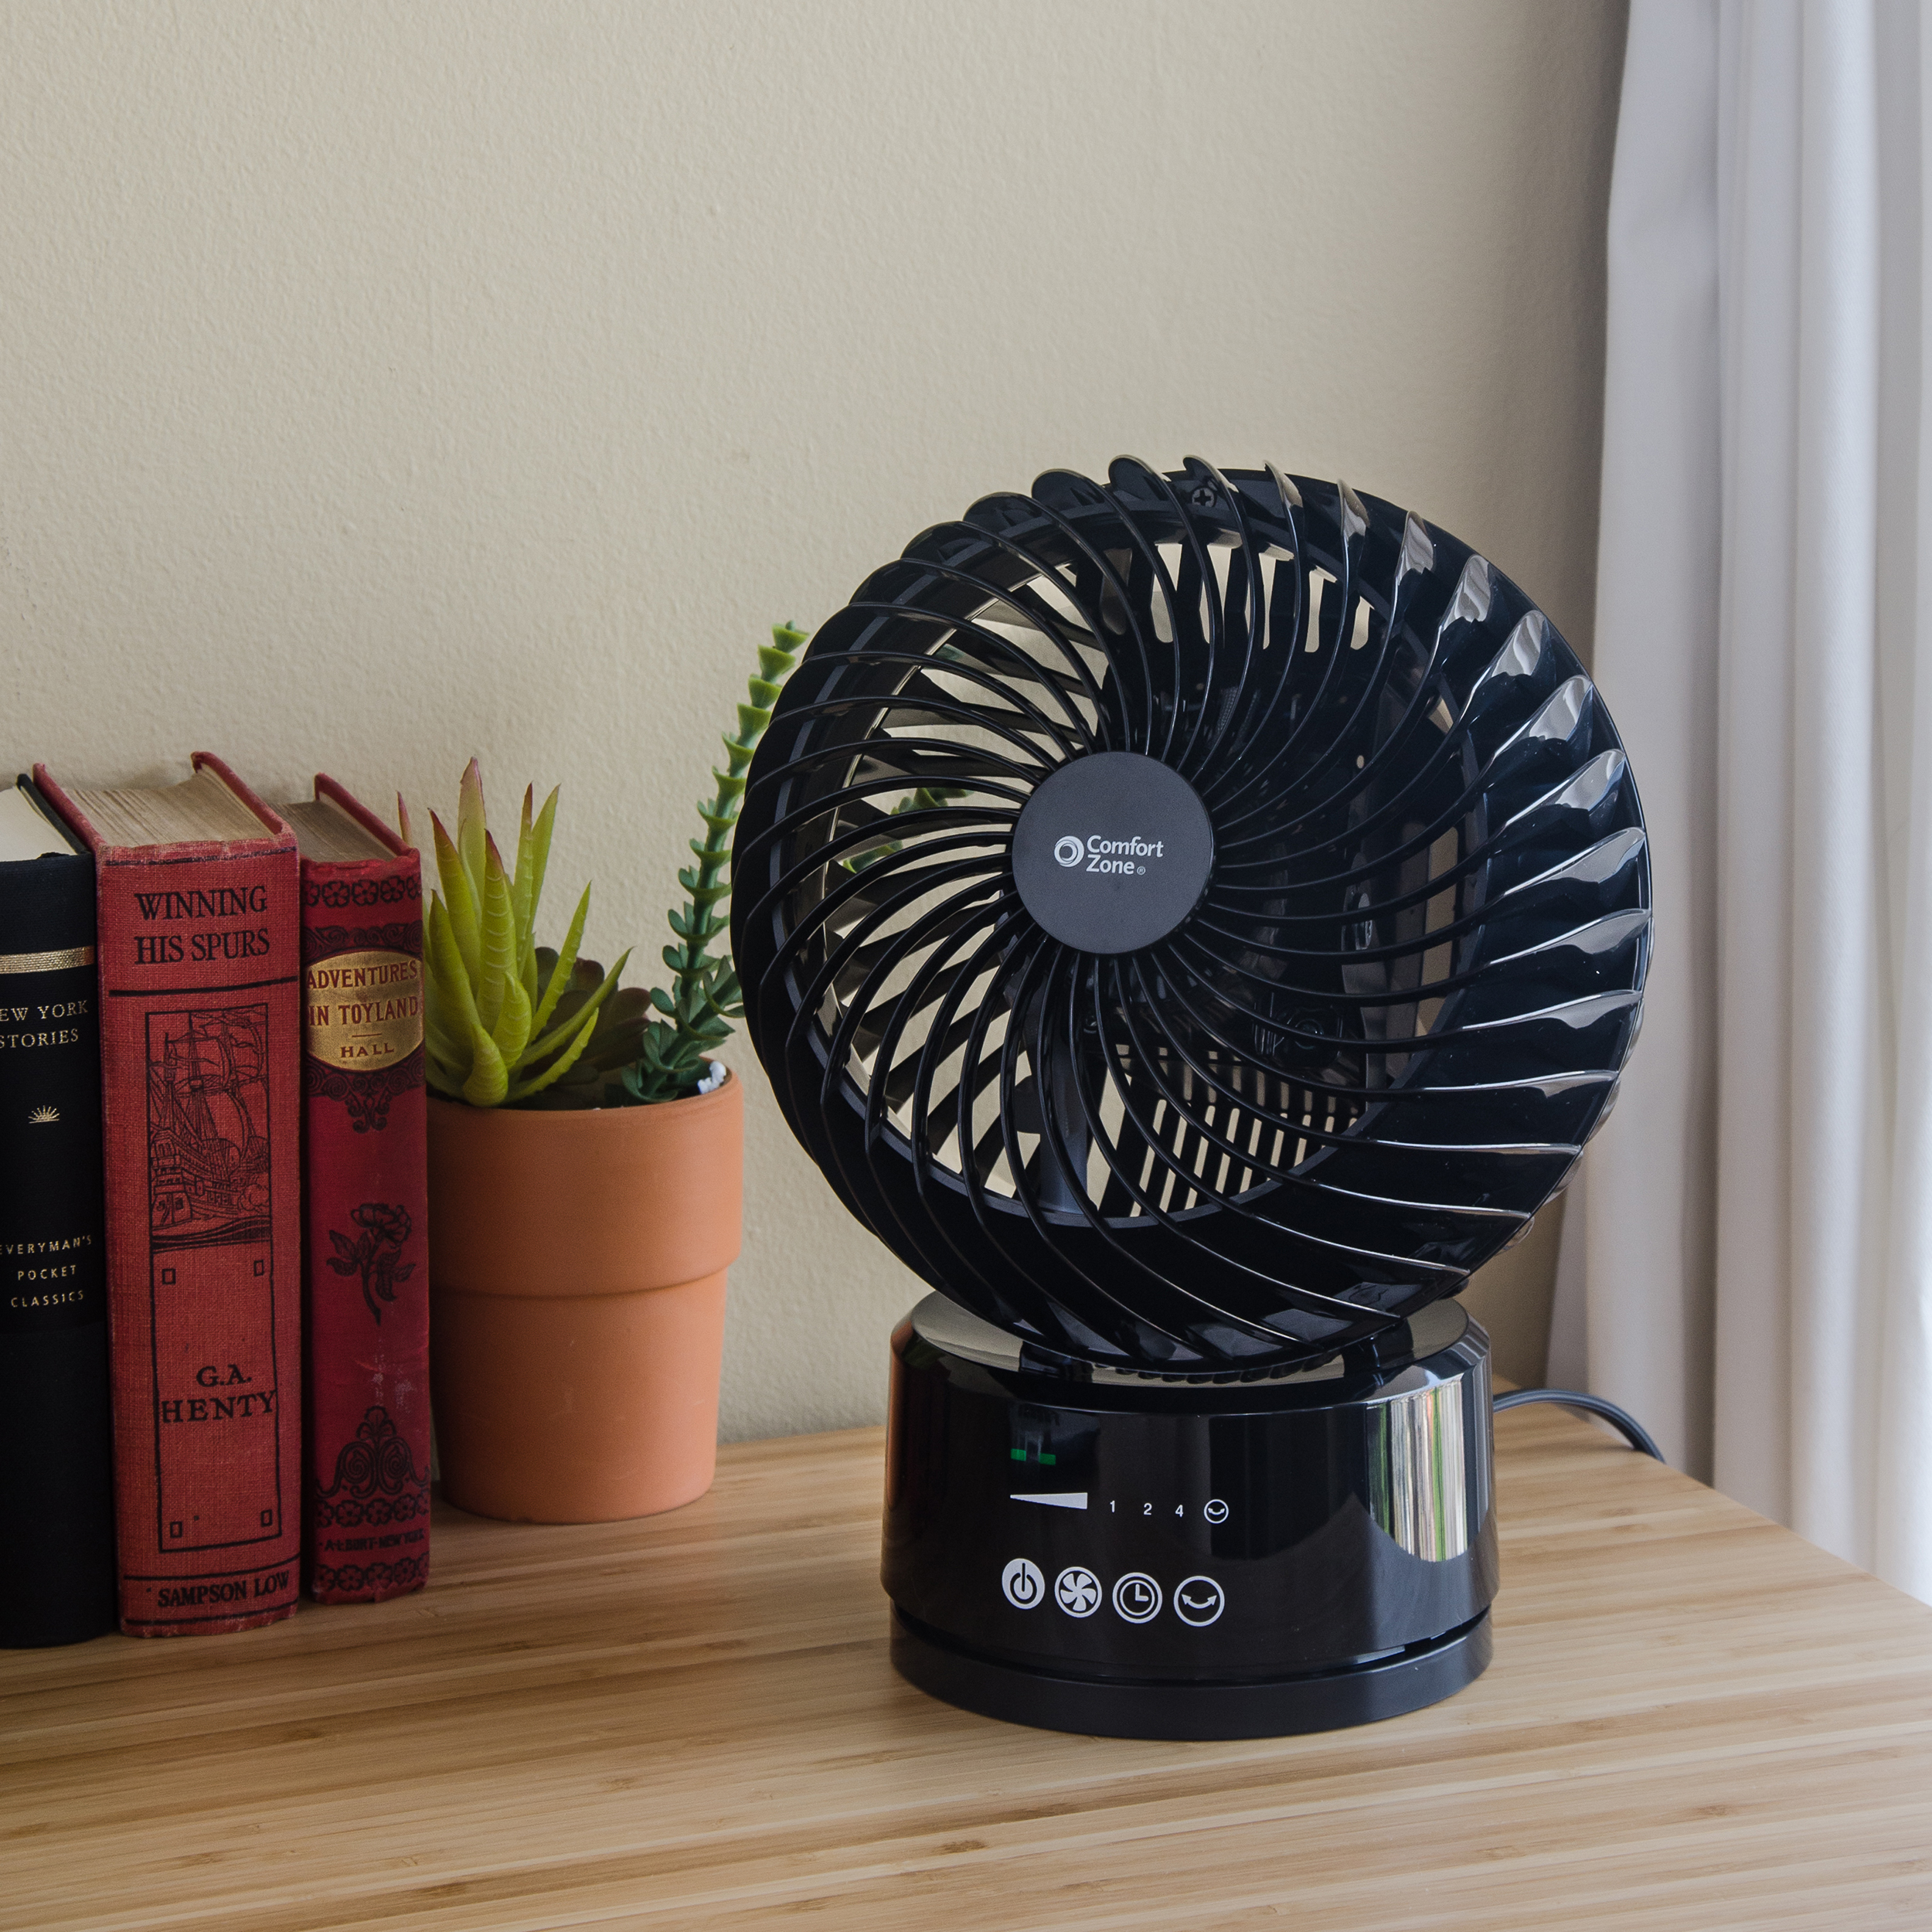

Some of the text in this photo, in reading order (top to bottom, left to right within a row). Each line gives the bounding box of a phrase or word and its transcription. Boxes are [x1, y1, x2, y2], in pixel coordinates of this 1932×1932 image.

[1087, 835, 1164, 858] Comfort
[134, 885, 268, 921] WINNING
[134, 927, 270, 965] HIS SPURS
[307, 960, 418, 989] ADVENTURES
[36, 999, 88, 1020] YORK
[309, 995, 419, 1026] IN TOYLAND
[0, 1028, 79, 1049] STORIES
[340, 1043, 395, 1059] HALL
[17, 1264, 77, 1281] POCKET
[10, 1290, 83, 1308] CLASSICS
[196, 1364, 253, 1388] G.A.
[161, 1389, 277, 1423] HENTY
[1109, 1499, 1184, 1518] 1 2 4
[157, 1570, 290, 1607] SAMPSON LOW
